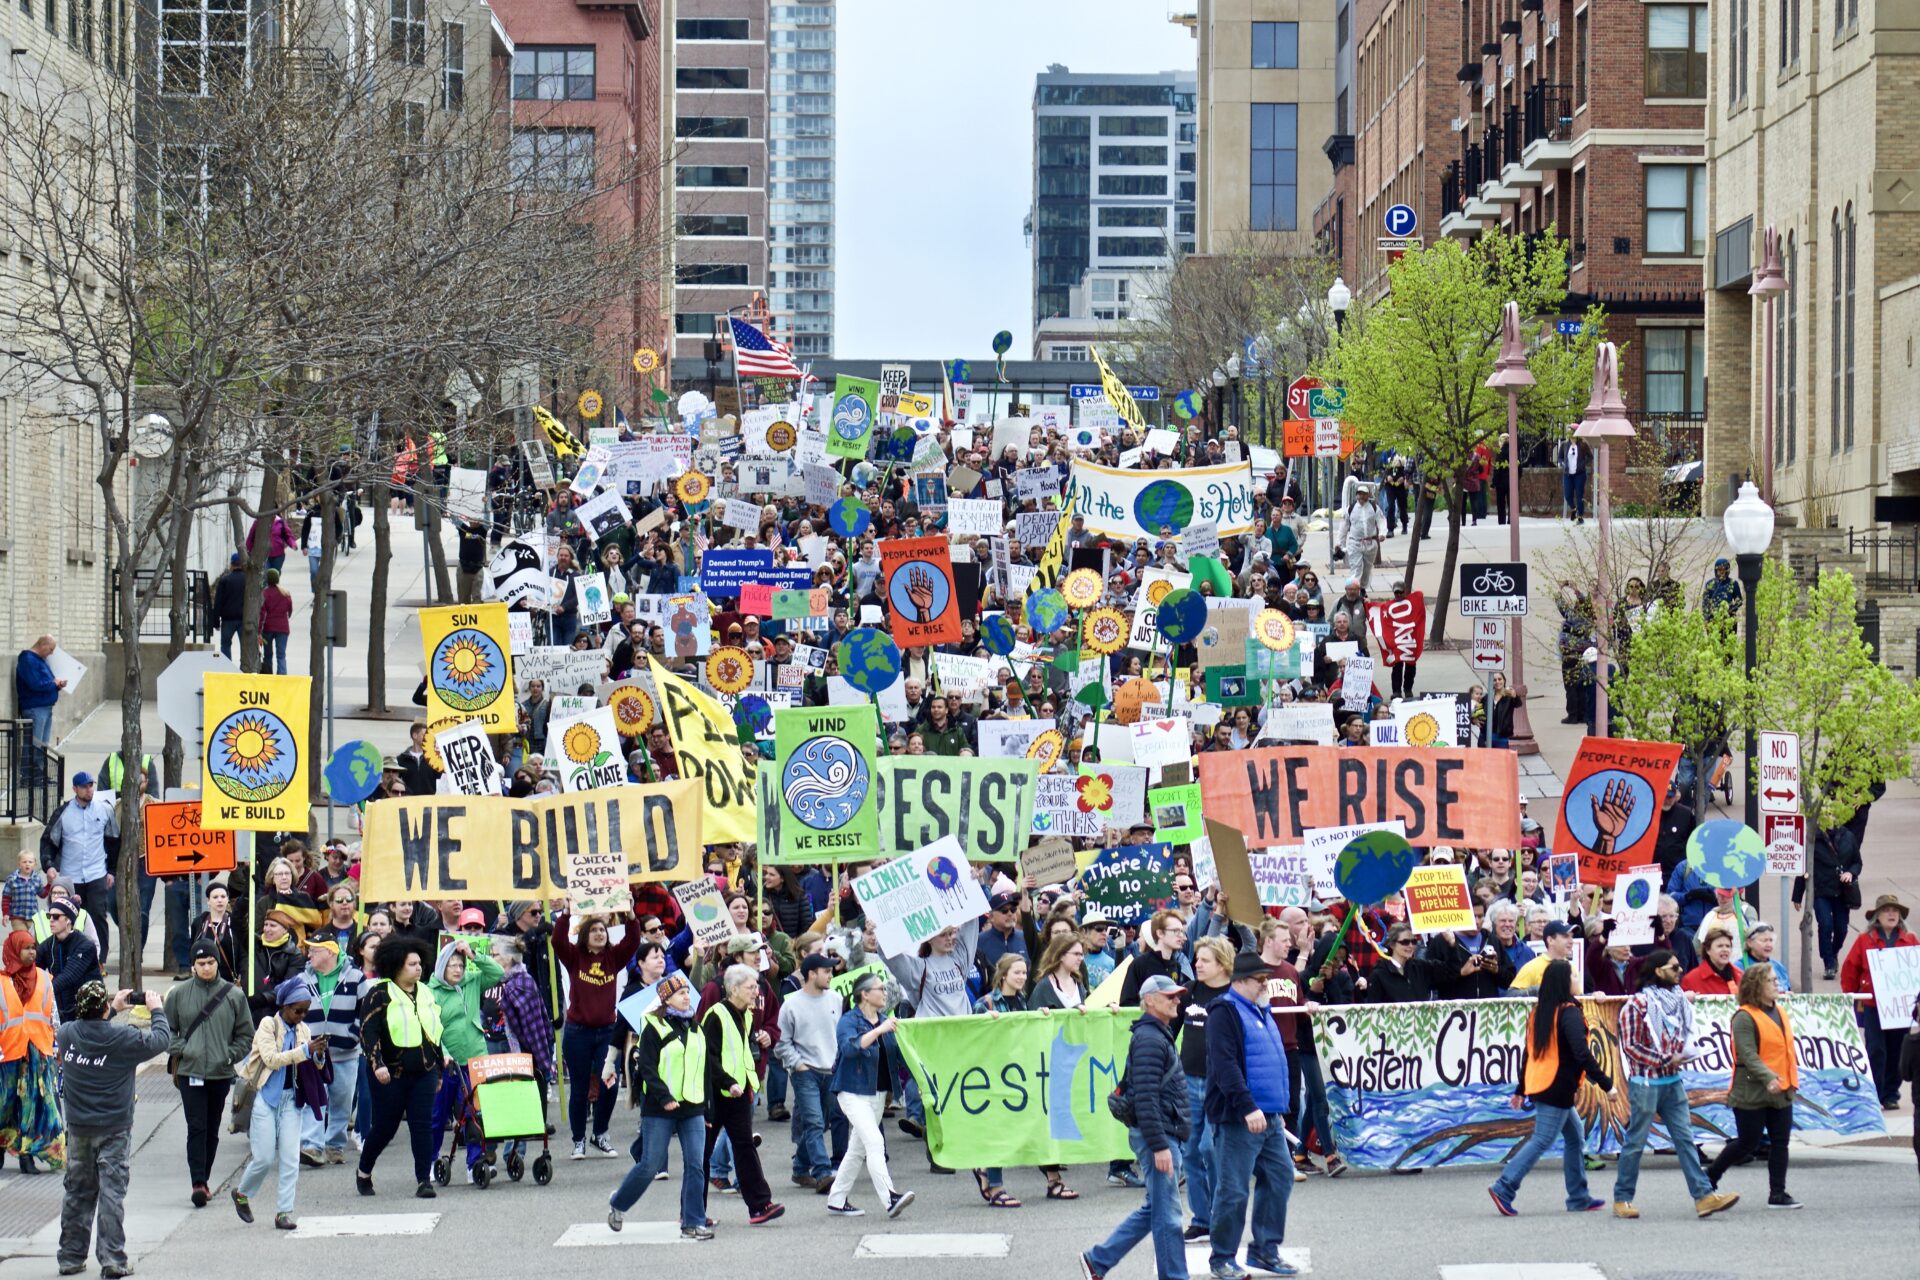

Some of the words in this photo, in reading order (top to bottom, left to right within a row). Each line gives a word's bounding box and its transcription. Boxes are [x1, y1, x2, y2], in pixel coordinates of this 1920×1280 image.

[1392, 209, 1409, 232] P
[883, 370, 906, 383] KEEP
[848, 384, 865, 394] WIND
[1142, 389, 1155, 397] Av
[1321, 421, 1333, 431] NO
[720, 436, 739, 445] CLIMATE
[1316, 433, 1339, 442] STOPPING
[1026, 467, 1051, 475] TRUMP
[1062, 475, 1093, 516] All
[1096, 491, 1125, 520] the
[1200, 497, 1214, 518] is
[1208, 482, 1255, 525] Holy
[883, 549, 915, 560] PEOPLE
[917, 546, 945, 557] POWER
[738, 559, 765, 568] Trump's
[758, 571, 790, 579] Alternative
[790, 571, 811, 580] Energy
[719, 580, 727, 588] of
[775, 581, 794, 589] NOT
[1463, 599, 1488, 612] BIKE
[1498, 599, 1525, 612] LANE
[451, 614, 478, 627] SUN
[583, 611, 609, 623] MOTHER
[908, 626, 922, 636] WE
[923, 624, 945, 635] RISE
[1388, 599, 1417, 662] MAYO
[1483, 622, 1497, 635] NO
[1475, 638, 1504, 650] STOPPING
[520, 654, 551, 668] WAR
[780, 666, 802, 676] RESIST
[779, 675, 802, 685] TRUMP
[239, 691, 270, 705] SUN
[808, 717, 846, 733] WIND
[1134, 723, 1152, 737] I
[443, 735, 482, 773] KEEP
[1771, 740, 1787, 759] NO
[1579, 751, 1632, 767] PEOPLE
[1631, 756, 1671, 770] POWER
[454, 771, 467, 787] IT
[466, 767, 479, 782] IN
[1763, 765, 1797, 782] STOPPING
[1035, 793, 1069, 809] YOUR
[1156, 791, 1181, 804] DON'T
[1187, 789, 1198, 799] BE
[1247, 756, 1314, 840] WE
[1338, 758, 1465, 840] RISE
[220, 807, 240, 819] WE
[245, 807, 285, 820] BUILD
[154, 832, 226, 848] DETOUR
[399, 806, 468, 891] WE
[511, 794, 680, 891] BUILD
[795, 835, 813, 849] WE
[818, 833, 862, 847] RESIST
[1311, 836, 1327, 848] IT'S
[1329, 832, 1350, 842] NOT
[1774, 844, 1795, 853] SNOW
[573, 854, 622, 866] WHICH
[1249, 855, 1309, 873] CLIMATE
[1551, 856, 1576, 867] KEEP
[1767, 853, 1802, 862] EMERGENCY
[575, 866, 616, 877] GREEN
[1084, 855, 1141, 881] There
[1147, 855, 1162, 874] is
[1597, 857, 1627, 873] RISE
[1772, 861, 1796, 871] ROUTE
[570, 879, 591, 889] DO
[599, 878, 625, 888] YOU
[856, 857, 920, 902] CLIMATE
[1254, 871, 1301, 886] CHANGE
[1413, 871, 1439, 883] STOP
[1440, 871, 1454, 881] THE
[584, 887, 612, 896] SEE?
[675, 884, 691, 897] YOU
[690, 877, 711, 892] CAN'T
[1119, 878, 1141, 894] no
[1414, 884, 1460, 898] ENBRIDGE
[1085, 900, 1143, 919] planet
[1420, 897, 1460, 911] PIPELINE
[902, 904, 942, 943] NOW!
[1422, 912, 1464, 925] INVASION
[695, 919, 728, 937] CLIMATE
[1870, 950, 1885, 971] IF
[472, 1058, 504, 1069] CLEAN
[506, 1056, 533, 1068] ENERGY
[1327, 1015, 1423, 1114] System
